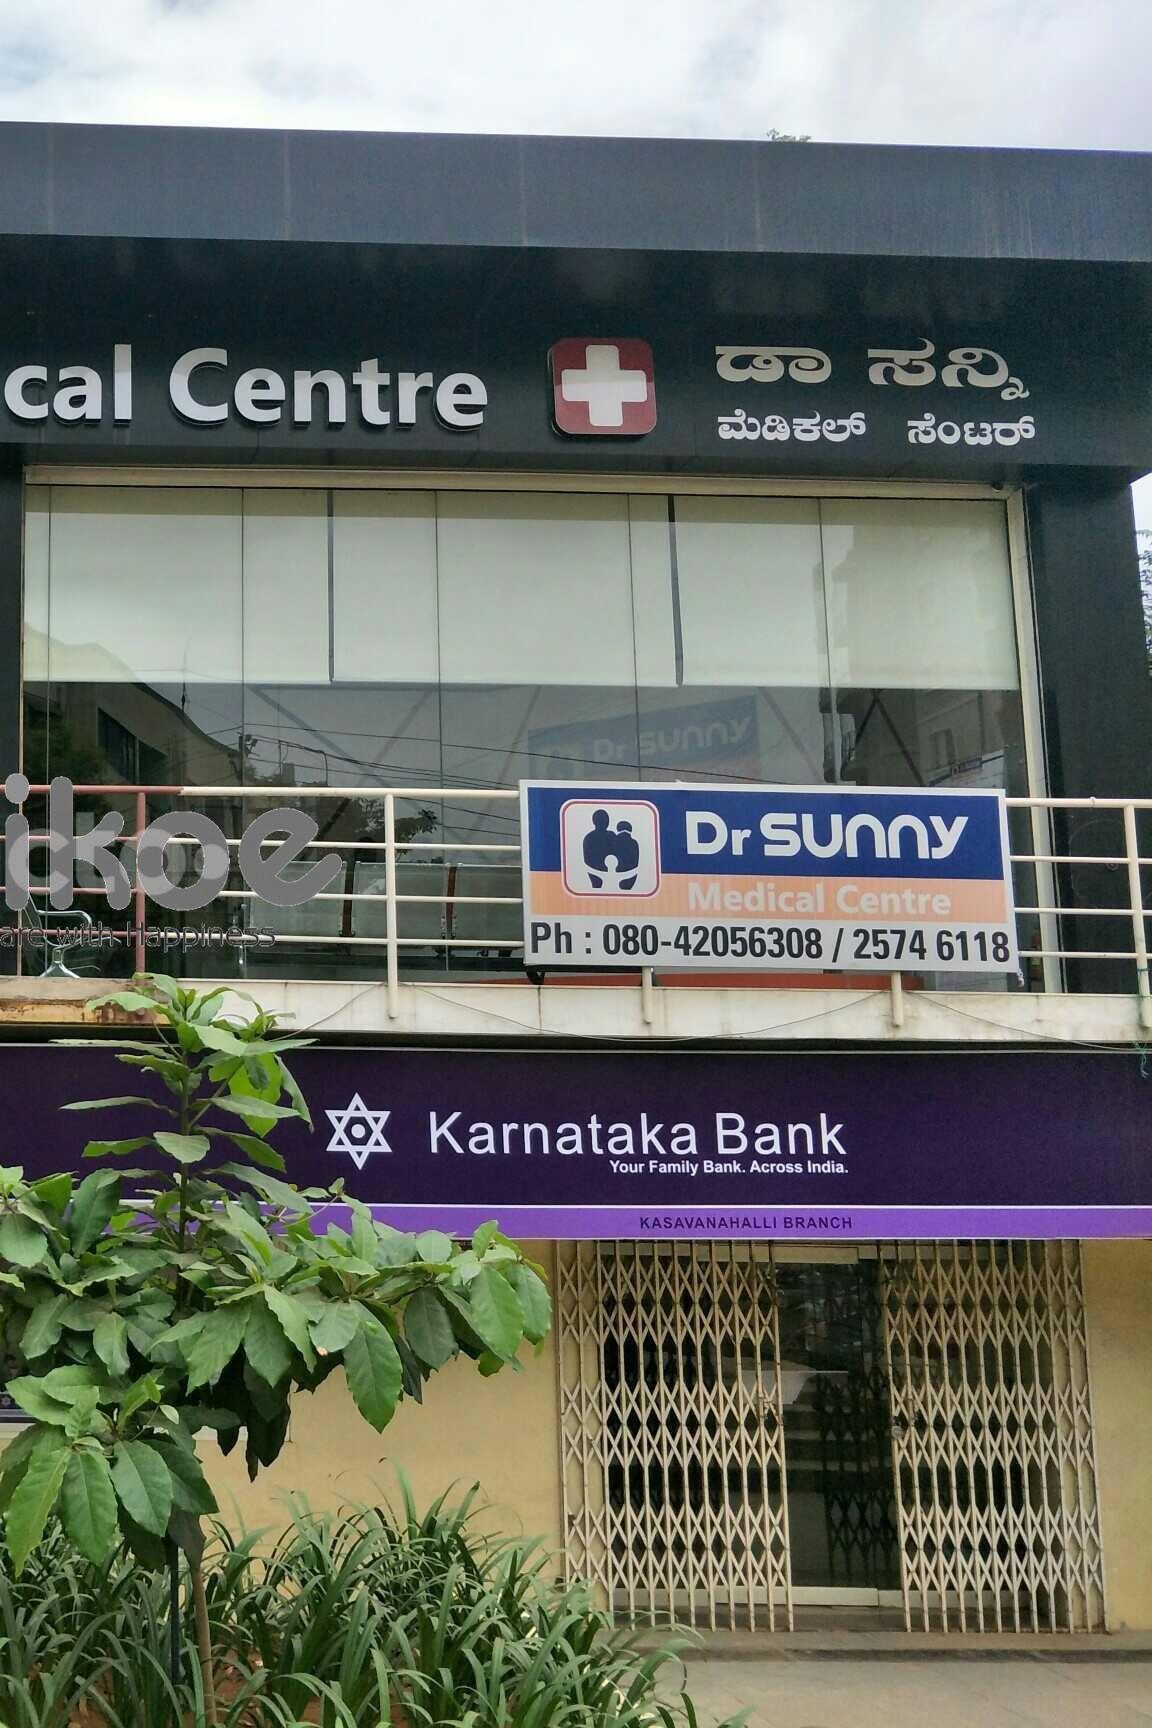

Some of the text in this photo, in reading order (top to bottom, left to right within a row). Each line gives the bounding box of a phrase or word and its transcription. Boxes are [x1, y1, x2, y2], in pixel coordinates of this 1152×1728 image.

[169, 347, 488, 428] Centre
[715, 338, 1030, 400] ಡಾ ಸನ್ನಿ
[717, 408, 1036, 447] ಮೆಡಿಕಲ್ ಸೆಂಟರ್
[685, 810, 751, 856] Dr
[687, 880, 952, 915] Medical Centre
[530, 922, 573, 954] Ph
[602, 923, 824, 960] 080-42056308
[852, 929, 927, 960] 2574
[936, 929, 1011, 963] 6118
[429, 1111, 849, 1156] Karnataka Bank
[609, 1160, 849, 1177] Your Family Bank. Across India.
[639, 1216, 853, 1230] KASAVANAHALLI BRANCH
